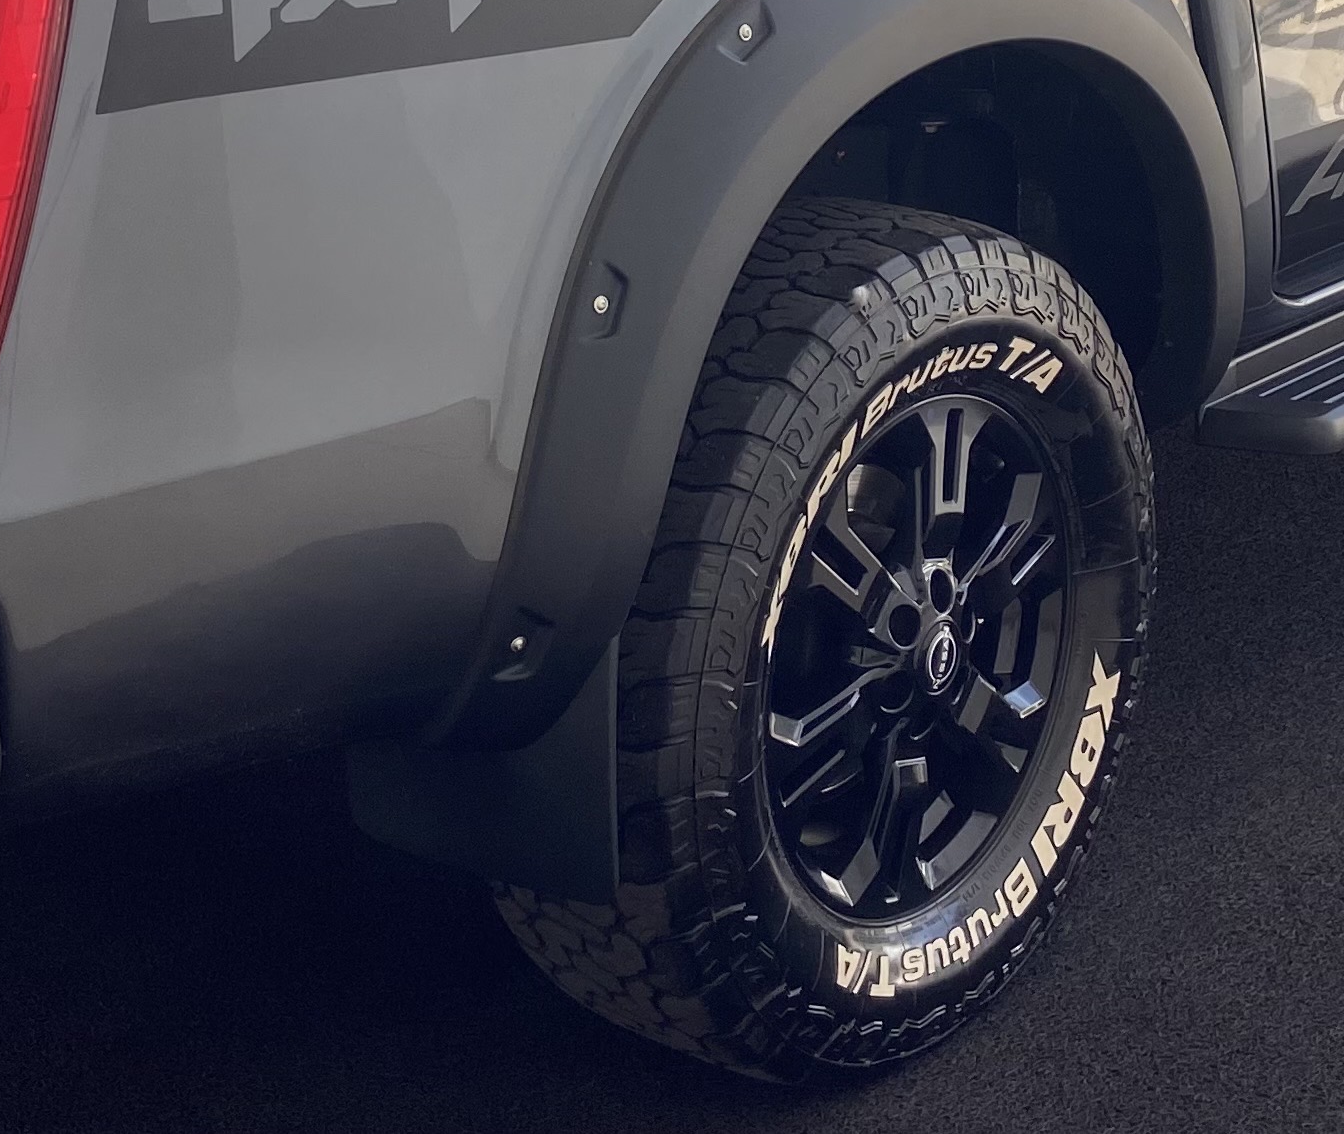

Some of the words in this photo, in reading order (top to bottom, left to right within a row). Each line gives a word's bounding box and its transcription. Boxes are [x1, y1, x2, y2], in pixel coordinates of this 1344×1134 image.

[860, 342, 998, 438] Brutus
[998, 336, 1064, 394] T/A
[1030, 649, 1122, 877] XBRI
[836, 943, 897, 998] T/A
[903, 856, 1039, 983] Brutus
